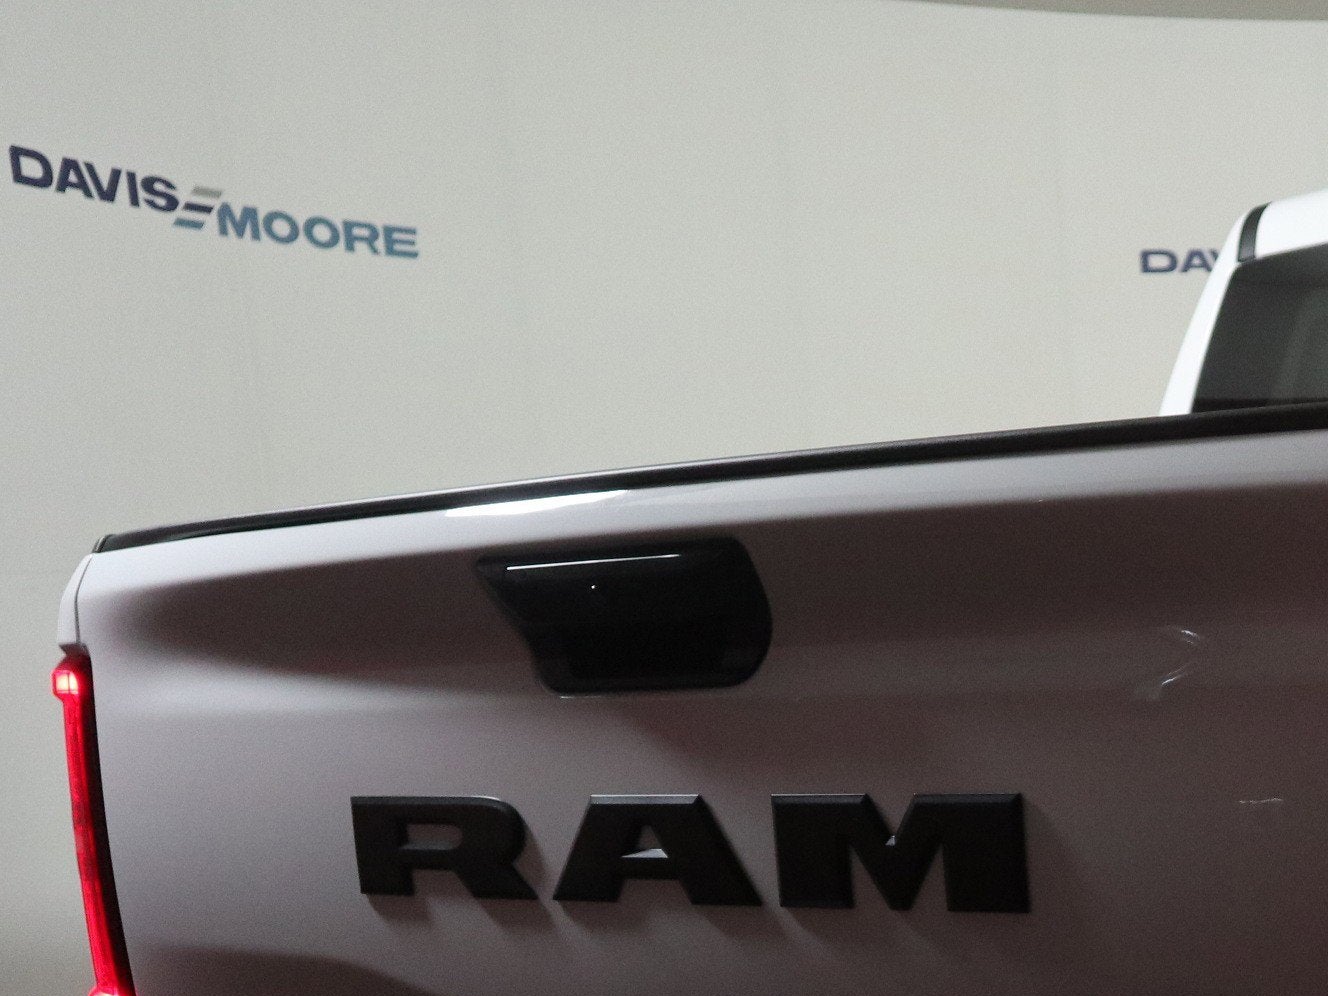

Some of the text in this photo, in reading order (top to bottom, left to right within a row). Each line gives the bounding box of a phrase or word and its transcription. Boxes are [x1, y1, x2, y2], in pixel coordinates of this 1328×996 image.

[8, 144, 419, 259] DAVIS MOORE
[1140, 248, 1219, 273] DA
[349, 793, 1031, 914] RAM
